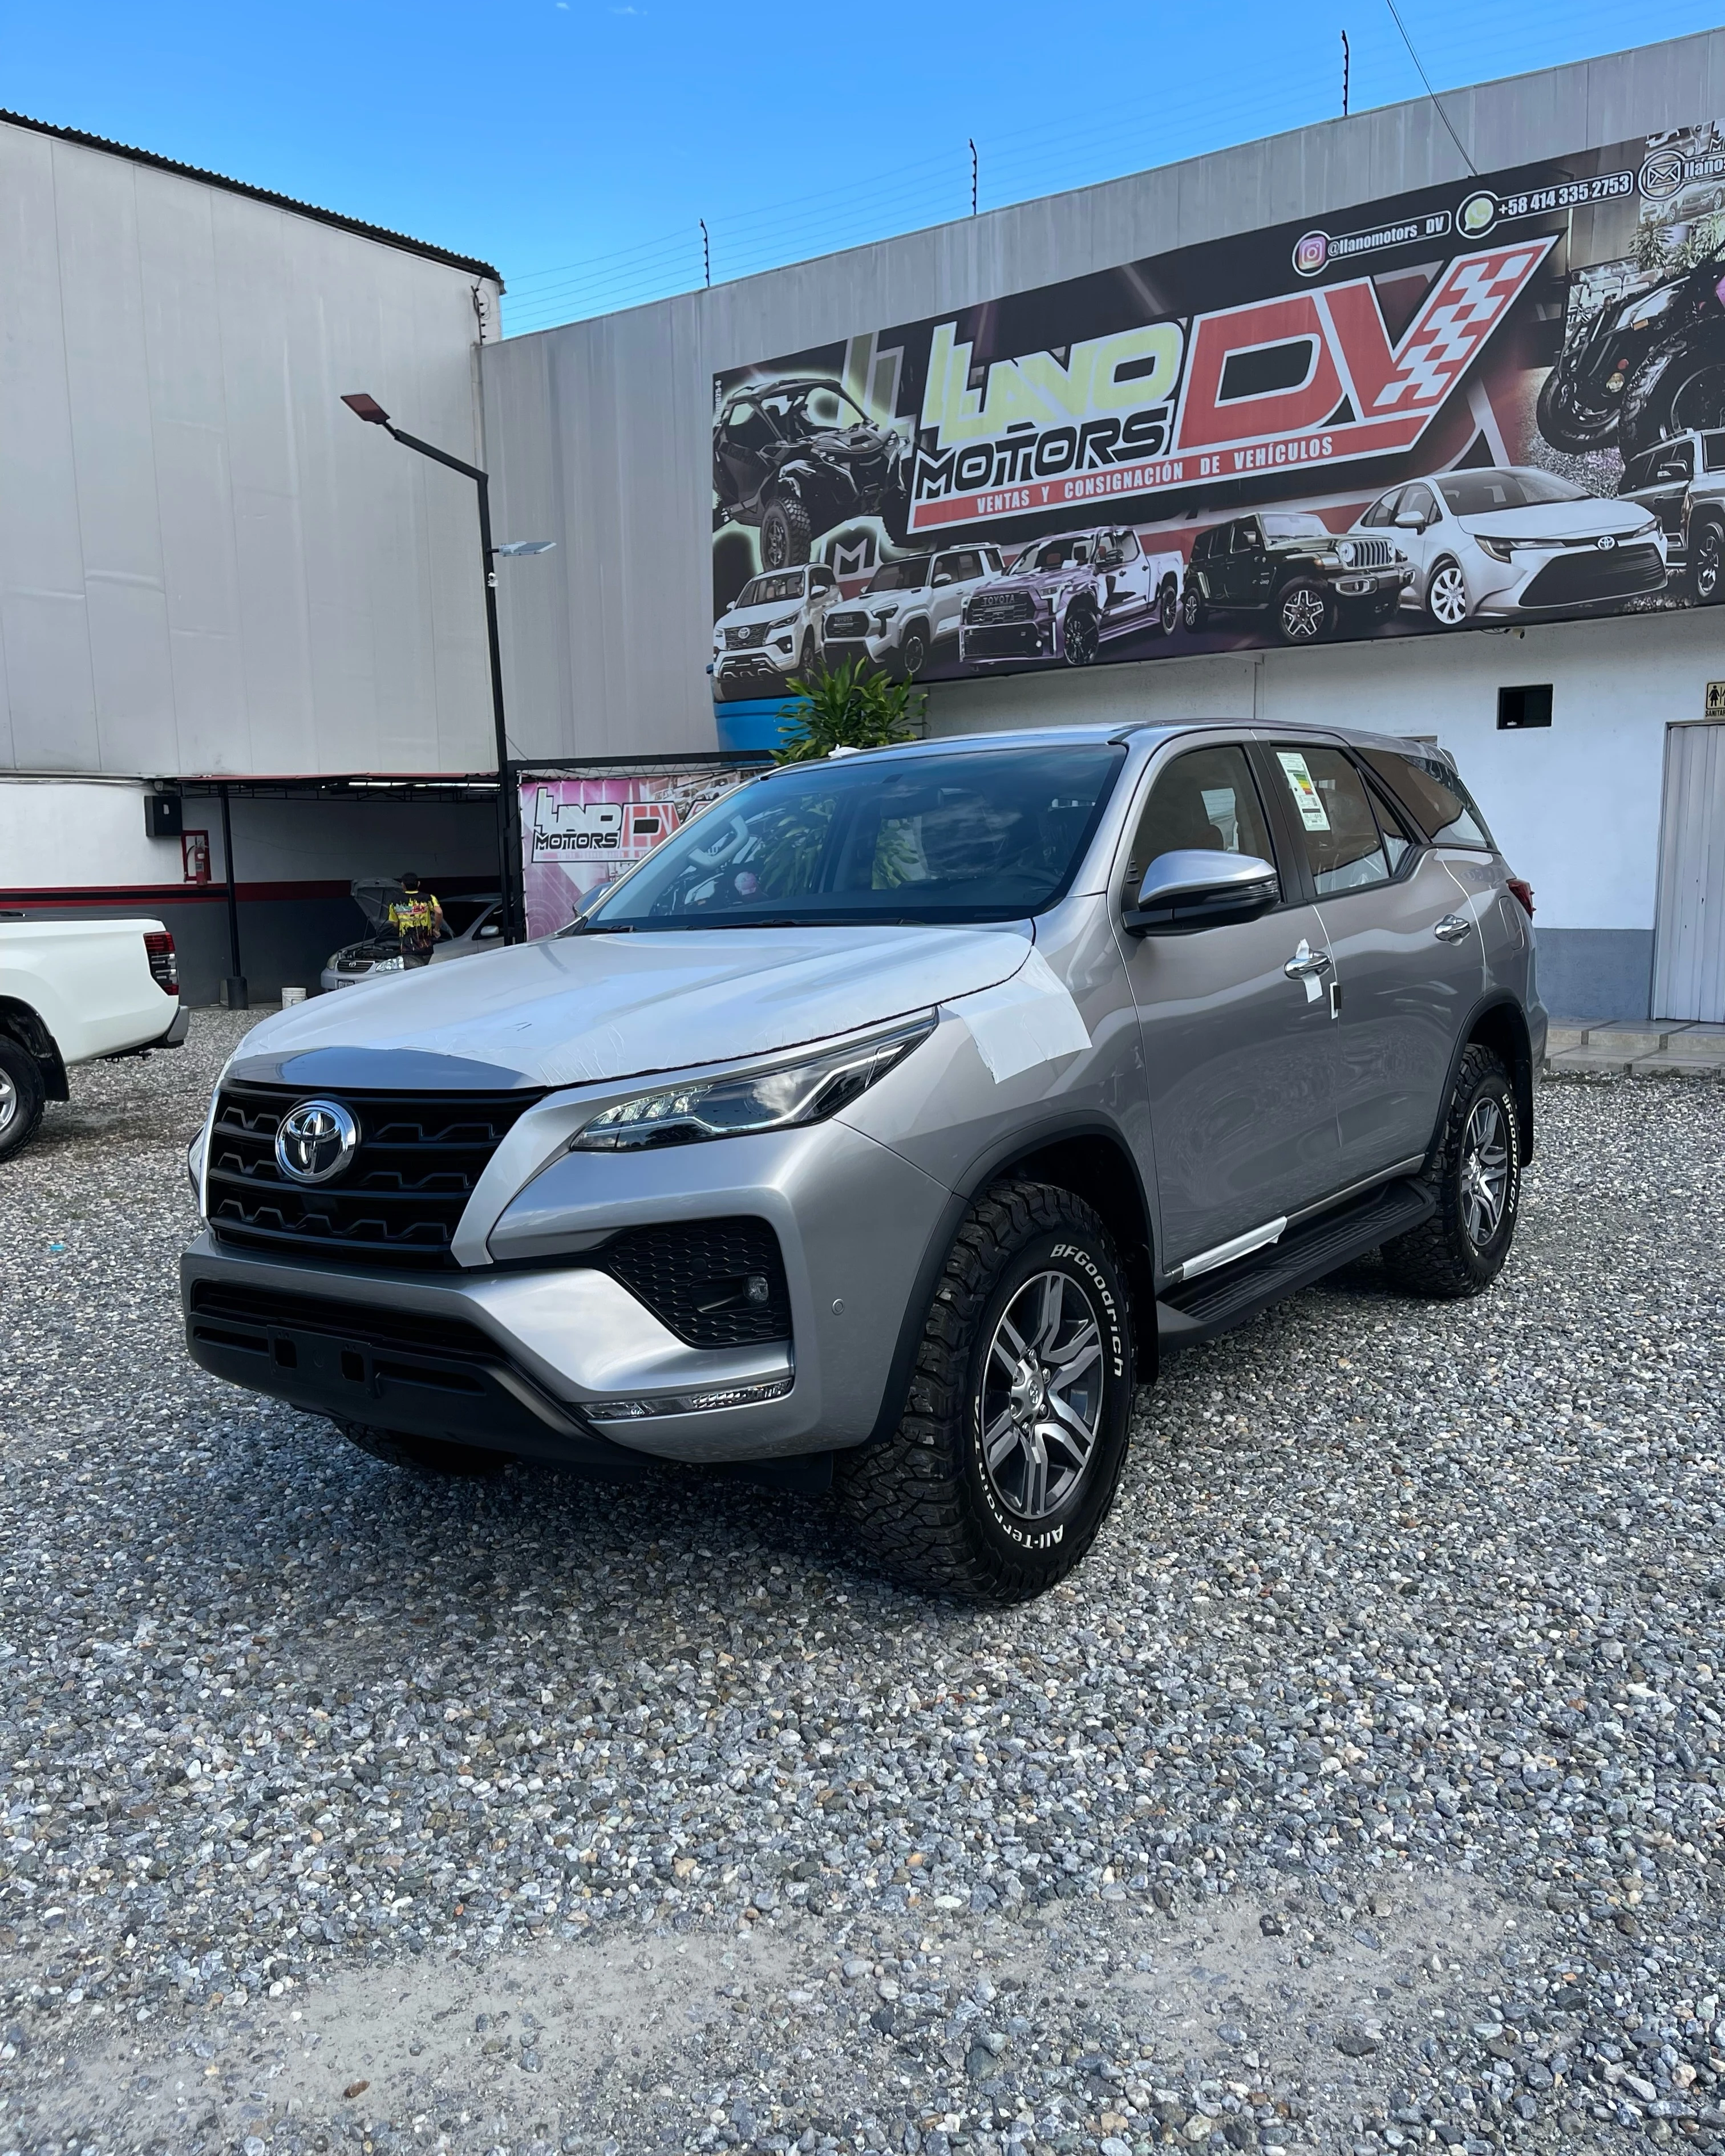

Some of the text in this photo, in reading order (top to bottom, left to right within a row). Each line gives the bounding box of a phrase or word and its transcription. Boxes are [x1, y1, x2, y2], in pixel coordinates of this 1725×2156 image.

[1499, 175, 1630, 216] +58 414 335 2753
[1175, 234, 1559, 453] DV
[914, 406, 1169, 500] MOTORS
[977, 436, 1333, 513] VENTAS Y CONSIGNACIÓN DE VEHÍCULOS
[983, 594, 1015, 605] TOYOTA
[535, 832, 620, 850] MOTORS
[1501, 1093, 1518, 1213] BFGoodrich
[1050, 1243, 1124, 1377] BFGoodrich
[978, 1462, 1064, 1549] All-Terrain
